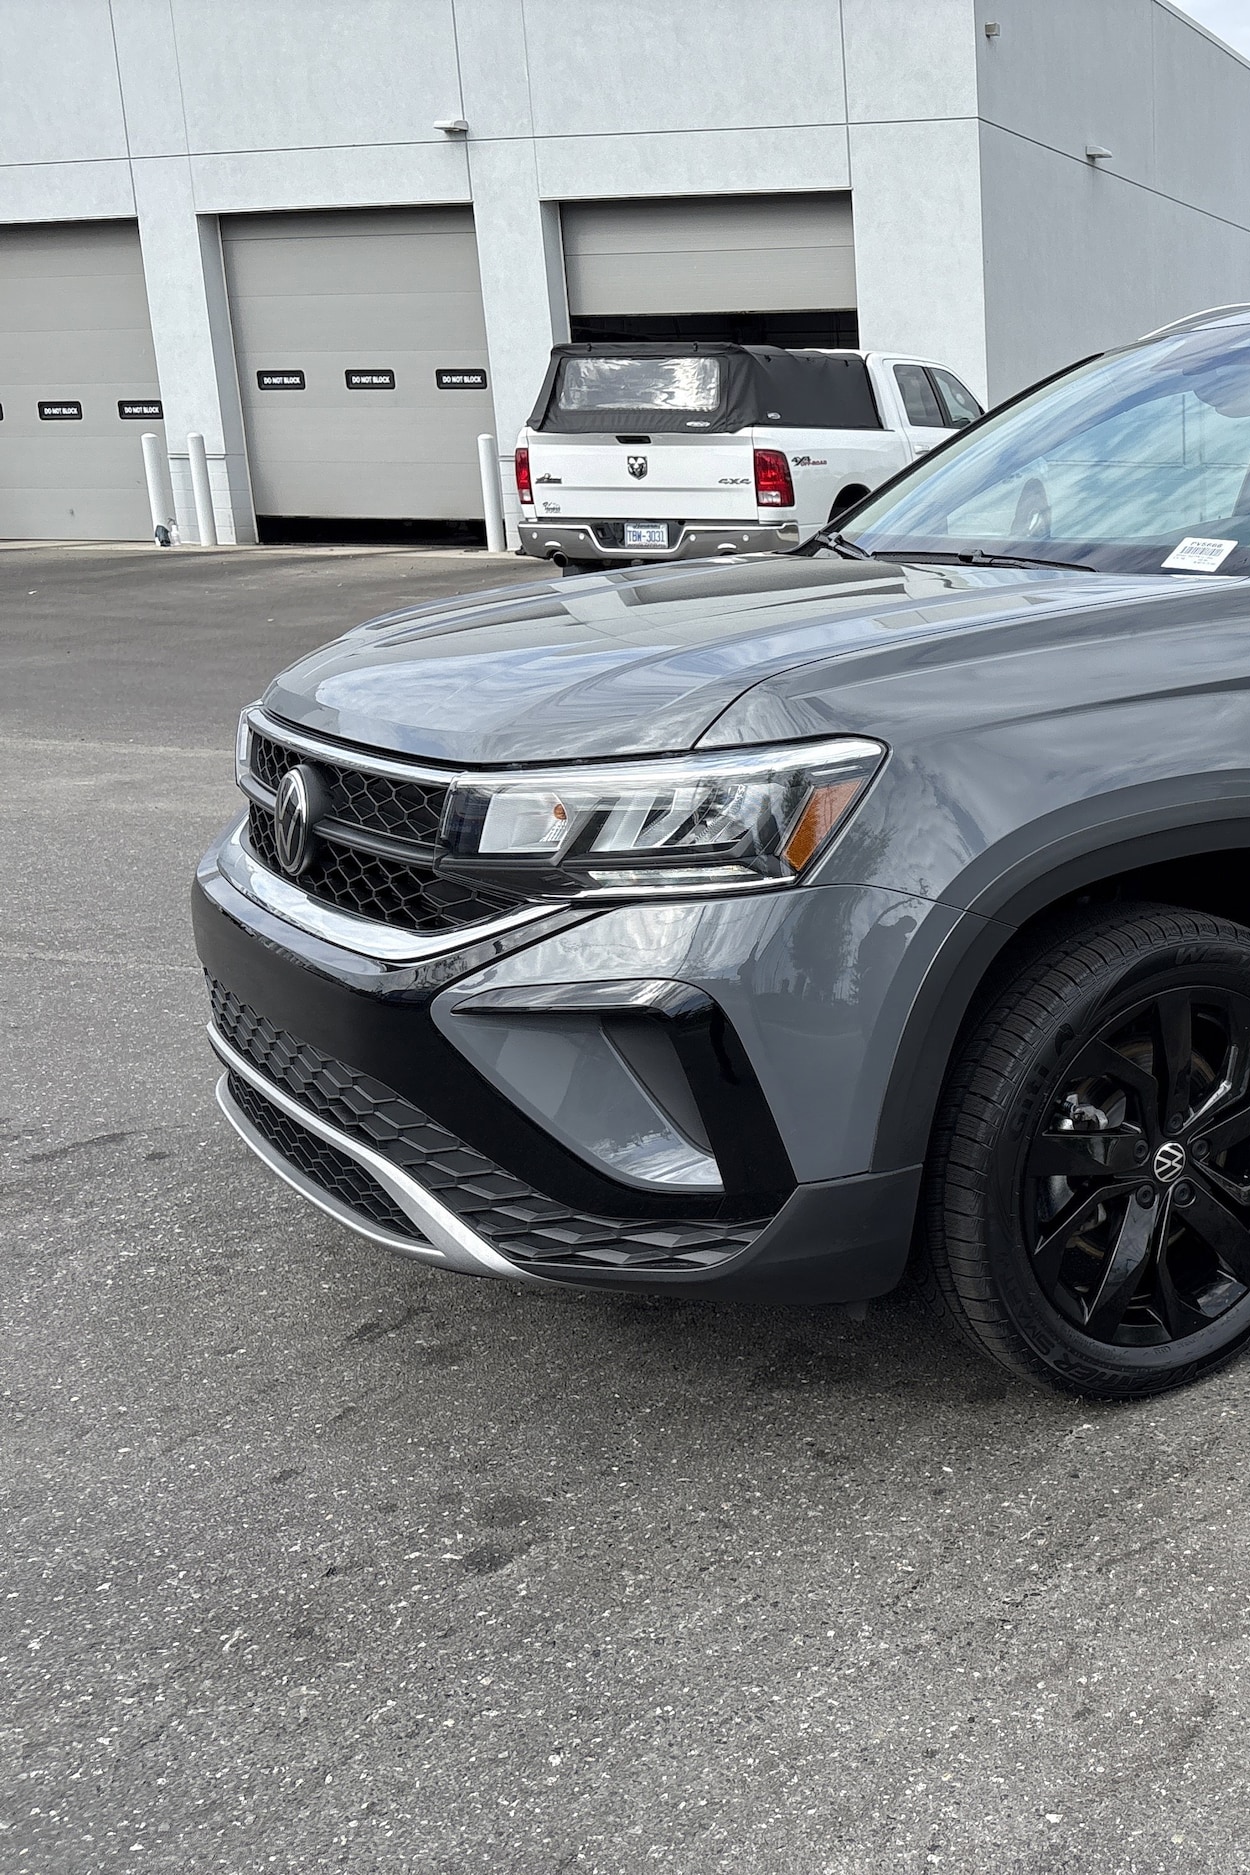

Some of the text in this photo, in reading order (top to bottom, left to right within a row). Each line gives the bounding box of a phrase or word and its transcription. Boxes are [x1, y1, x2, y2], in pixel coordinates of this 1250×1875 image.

[352, 376, 390, 384] DO NOT BLOCK
[442, 375, 481, 383] DO NOT BLOCK
[62, 407, 78, 415] BLOCK
